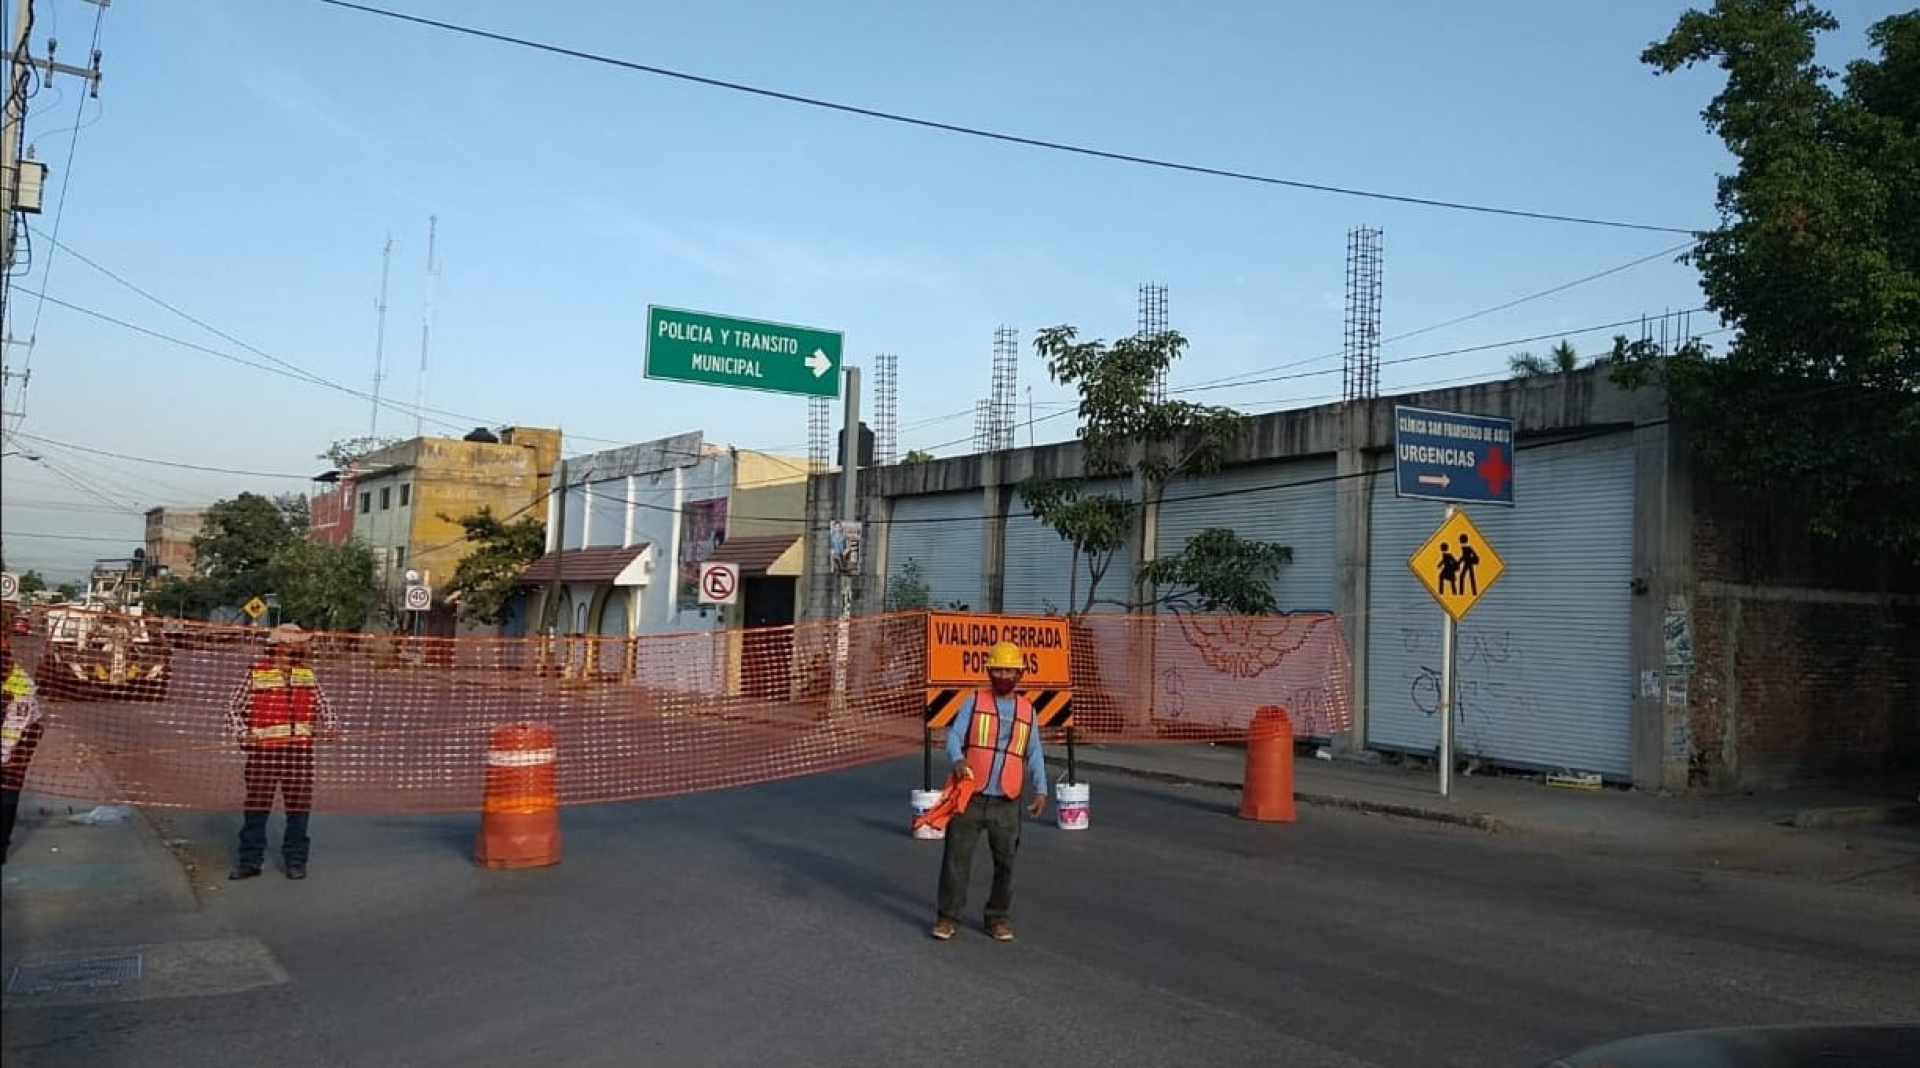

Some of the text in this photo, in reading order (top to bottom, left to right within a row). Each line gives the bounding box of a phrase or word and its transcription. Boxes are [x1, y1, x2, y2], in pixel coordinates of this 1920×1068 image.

[658, 319, 798, 355] POLICIA Y TRANSITO
[692, 353, 763, 378] MUNICIPAL
[1400, 443, 1475, 467] URGENCIAS
[937, 623, 1061, 647] VIALIDAD CERRADA
